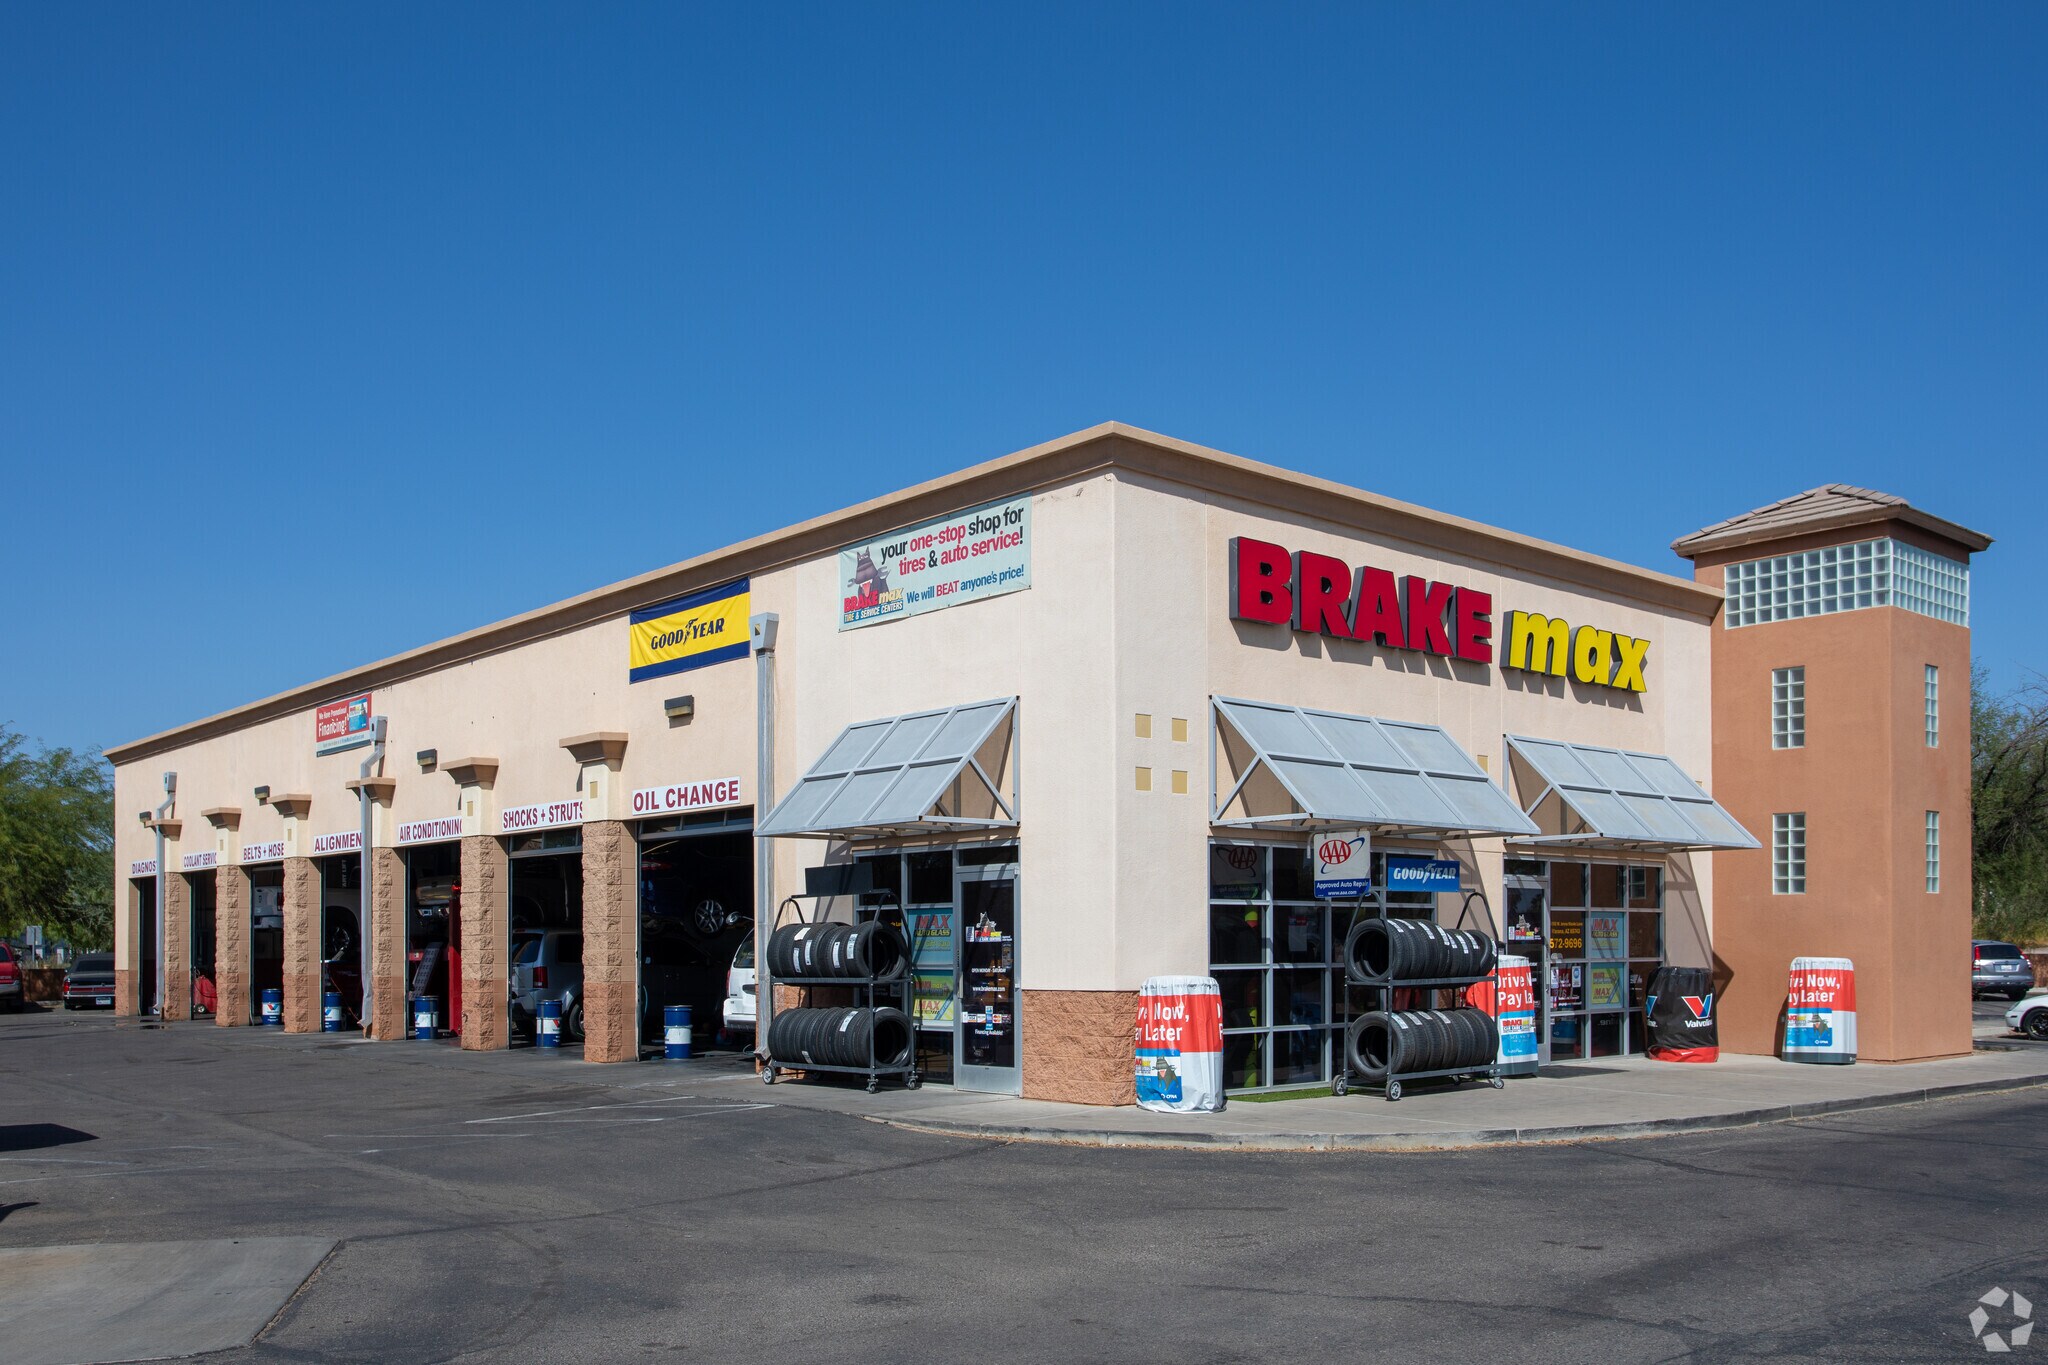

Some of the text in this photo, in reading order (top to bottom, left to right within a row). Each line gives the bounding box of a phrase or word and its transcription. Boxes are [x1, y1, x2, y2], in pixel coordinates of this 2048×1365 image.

[881, 506, 1024, 565] your one-stop shop for
[899, 526, 1024, 576] tires & auto service!
[906, 565, 1024, 604] We will BEAT anyone's price!
[843, 588, 904, 613] BRAKE max
[861, 607, 880, 618] SERVICE
[881, 602, 903, 613] CENTERS
[1229, 536, 1651, 693] BRAKE max
[319, 716, 347, 737] Financing!
[633, 780, 739, 812] OIL CHANGE
[503, 807, 538, 829] SHOCKS
[541, 809, 546, 822] +
[400, 825, 411, 842] AIR
[244, 846, 262, 860] BELTS
[1322, 840, 1349, 864] AAA
[132, 861, 157, 875] DIAGNOS
[184, 854, 202, 868] COOLANT
[1353, 880, 1369, 888] Repair
[916, 915, 951, 928] MAX
[1593, 919, 1618, 930] MAX
[1550, 938, 1583, 949] 572-9696
[1807, 974, 1840, 989] Now,
[1498, 991, 1522, 1008] Pay
[1595, 987, 1611, 996] MAX
[1801, 990, 1835, 1003] Later
[1154, 1002, 1190, 1022] Now,
[1145, 1024, 1183, 1041] Later
